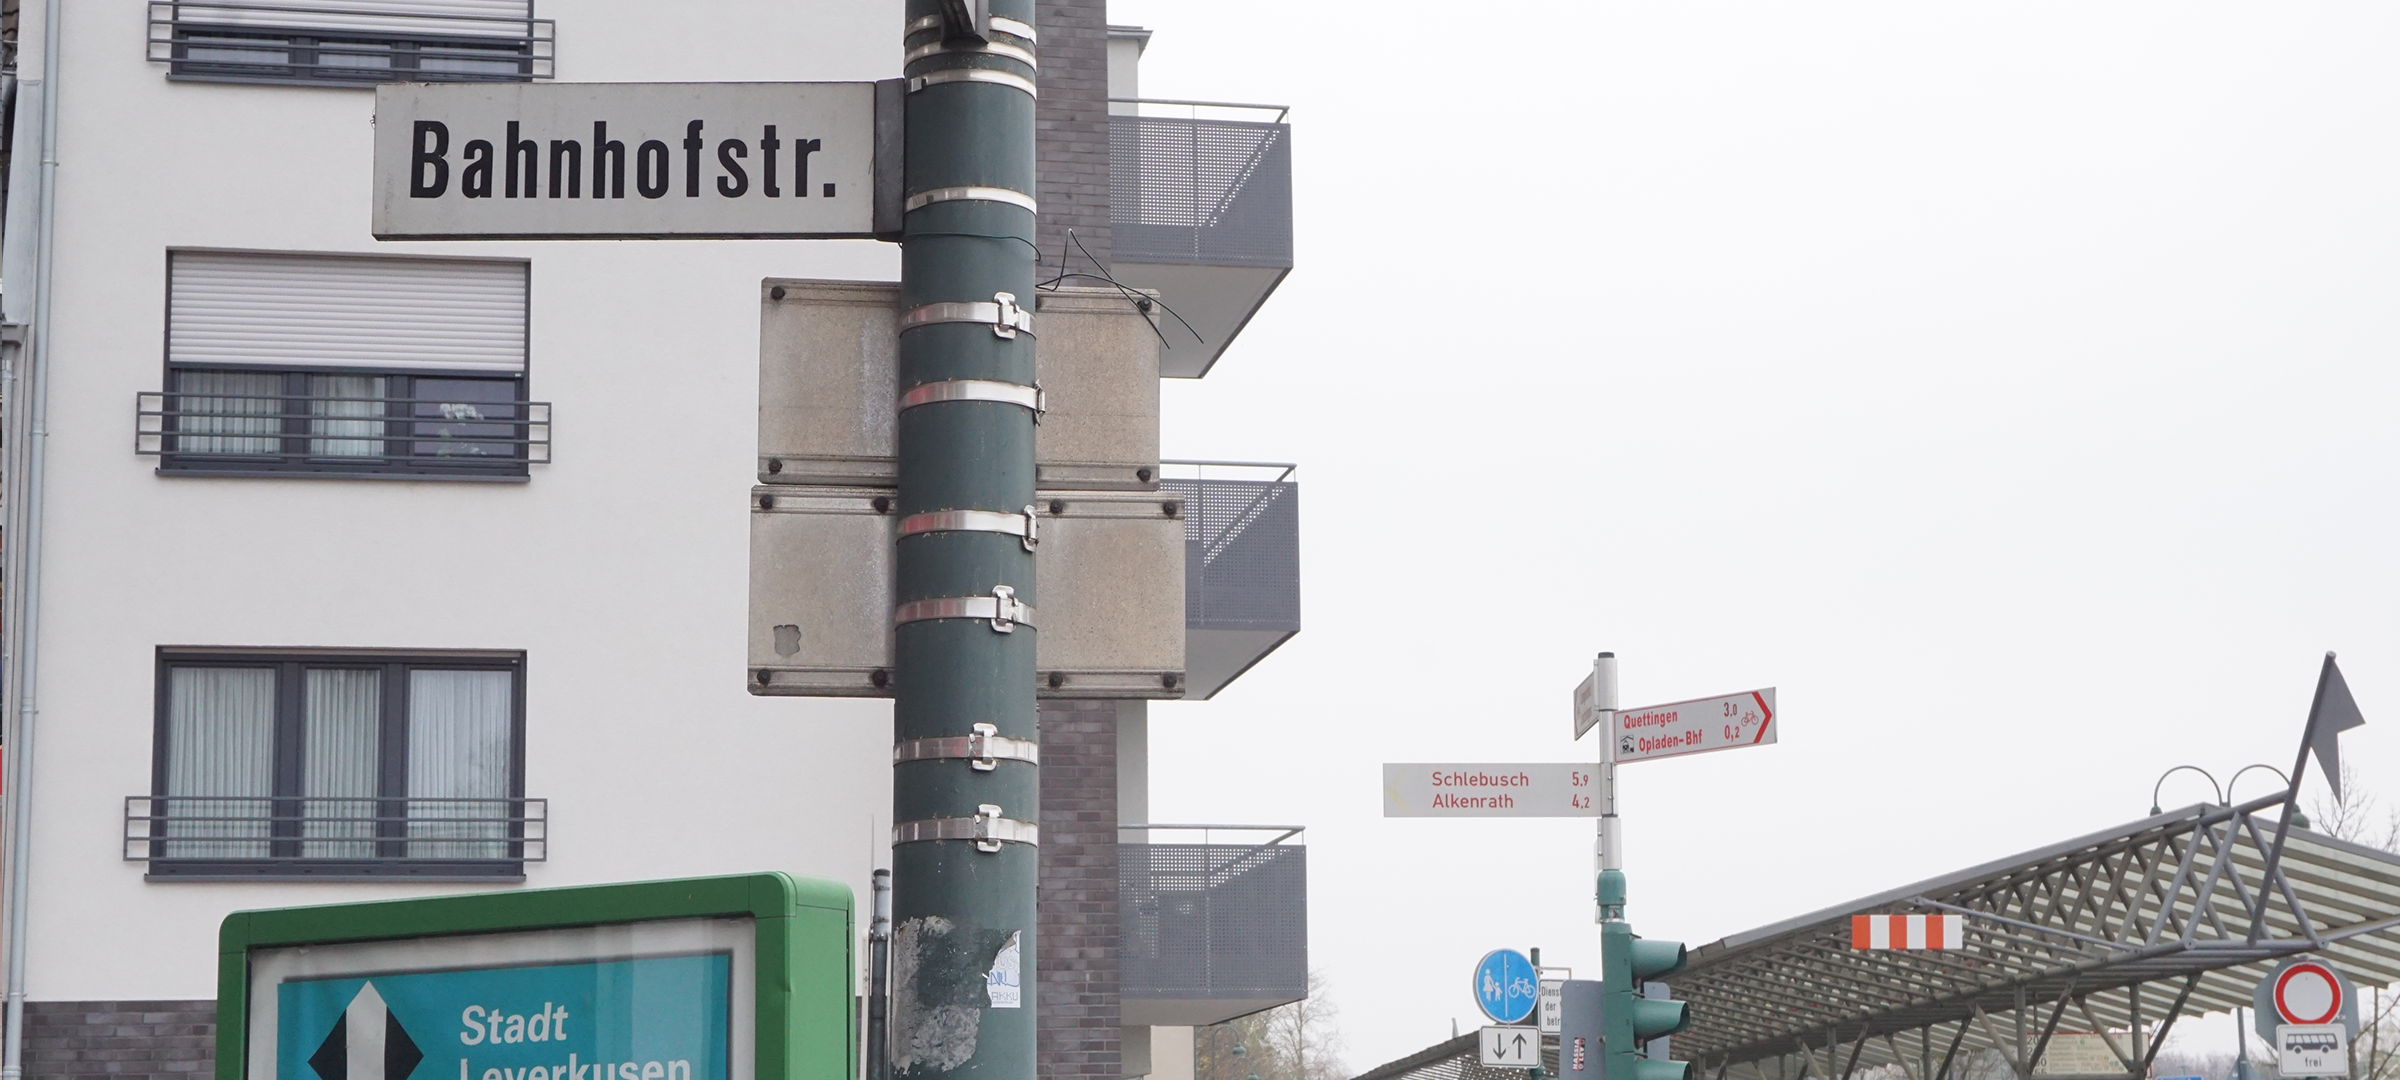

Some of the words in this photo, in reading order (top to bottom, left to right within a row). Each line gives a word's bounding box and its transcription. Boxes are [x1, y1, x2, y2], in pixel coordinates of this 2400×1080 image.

[409, 119, 836, 199] Bahnhofstr.
[1624, 711, 1678, 729] Quettingen
[1639, 729, 1703, 754] Opladen-Bhf
[1725, 725, 1740, 742] 0,2
[1432, 772, 1529, 787] Schlebusch
[1432, 794, 1514, 808] Alkenrath
[1572, 794, 1590, 809] 4,2
[1545, 1001, 1556, 1011] der
[460, 1002, 569, 1046] Stadt
[2305, 1056, 2322, 1067] frei
